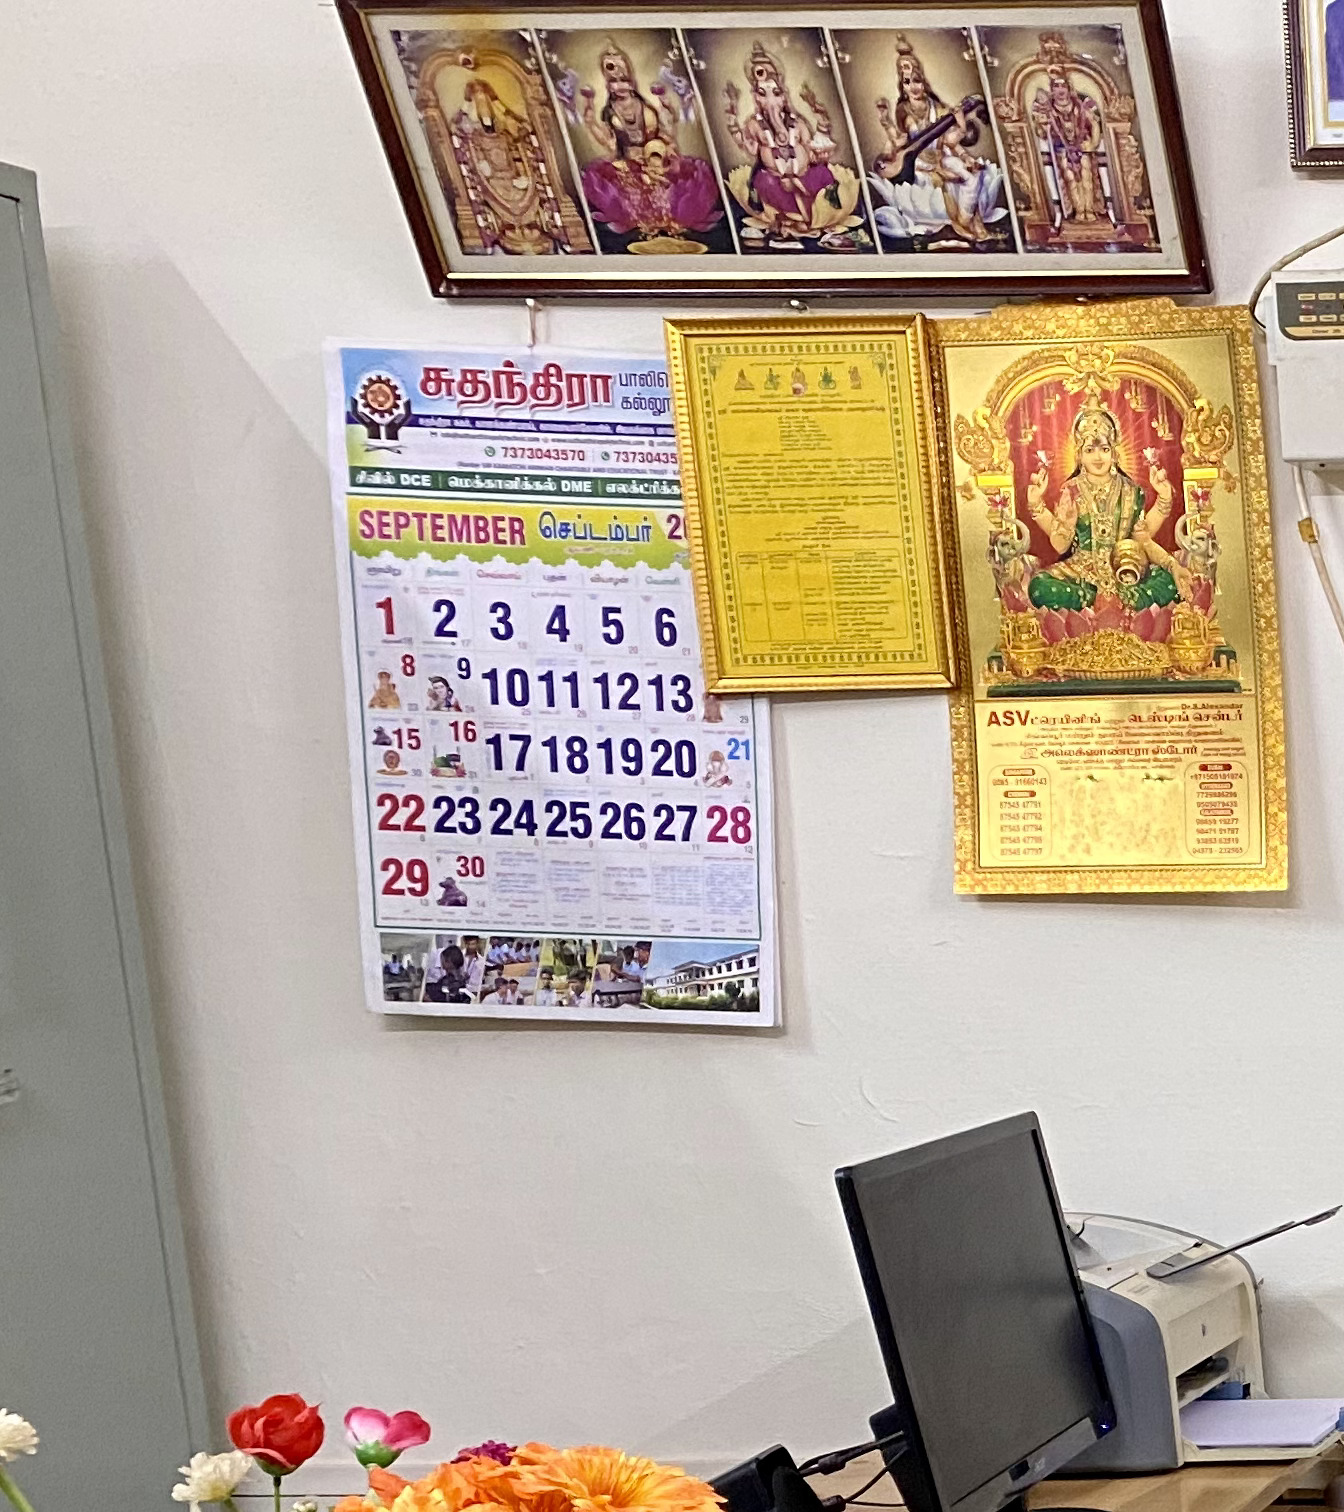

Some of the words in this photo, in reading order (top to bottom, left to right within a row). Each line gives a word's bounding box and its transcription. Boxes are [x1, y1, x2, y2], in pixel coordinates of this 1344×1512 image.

[419, 359, 613, 410] சுதந்திரா
[500, 446, 586, 462] 7373043570
[613, 450, 679, 465] 73730435
[400, 473, 432, 487] DCE
[561, 480, 592, 493] DME
[359, 509, 527, 546] SEPTEMBER
[538, 510, 652, 543] செப்டம்பர்
[375, 596, 395, 636] 1
[432, 598, 458, 639] 2
[489, 601, 514, 641] 3
[545, 604, 570, 643] 4
[601, 606, 625, 645] 5
[654, 607, 678, 648] 6
[401, 653, 416, 677] 8
[457, 657, 471, 680] 9
[481, 667, 530, 708] 10
[537, 669, 580, 709] 11
[592, 671, 641, 711] 12
[647, 673, 694, 714] 13
[986, 709, 1030, 727] ASV
[392, 727, 421, 751] 15
[449, 719, 477, 743] 16
[485, 732, 532, 772] 17
[541, 735, 589, 775] 18
[596, 737, 643, 777] 19
[650, 738, 697, 779] 20
[726, 736, 750, 761] 21
[376, 792, 426, 833] 22
[432, 795, 482, 835] 23
[489, 797, 538, 837] 24
[544, 799, 593, 839] 25
[599, 801, 646, 841] 26
[653, 803, 698, 842] 27
[706, 804, 752, 845] 28
[380, 857, 430, 898] 29
[456, 855, 485, 878] 30
